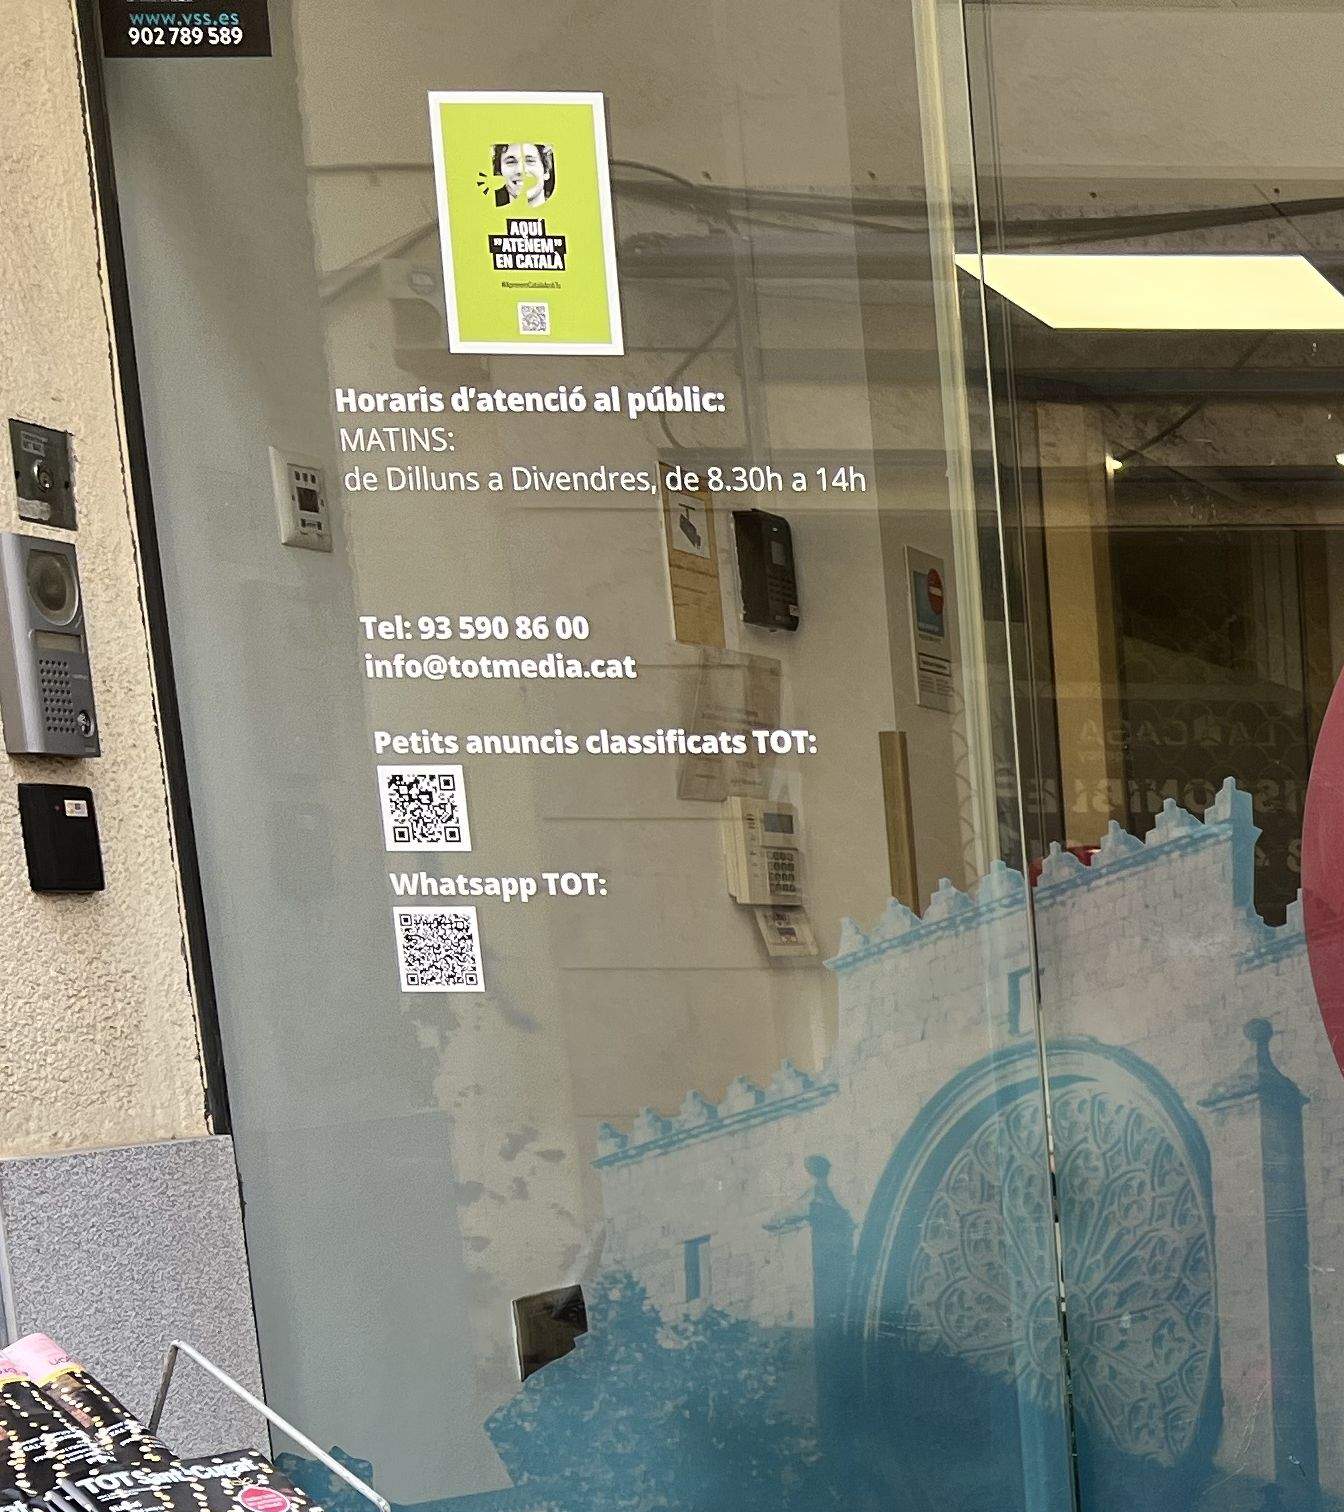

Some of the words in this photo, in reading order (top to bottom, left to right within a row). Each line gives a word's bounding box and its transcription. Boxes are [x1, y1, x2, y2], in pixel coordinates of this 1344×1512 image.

[129, 13, 240, 26] www.vss.es
[128, 27, 165, 45] 902
[169, 27, 203, 45] 789
[208, 27, 243, 45] 589
[495, 253, 513, 269] EN
[515, 251, 563, 270] CATALÀ
[335, 385, 445, 413] Horaris
[450, 385, 587, 412] d'atenció
[593, 385, 621, 412] al
[627, 385, 726, 420] públic:
[340, 427, 455, 452] MATINS:
[344, 465, 378, 492] de
[386, 465, 480, 492] Dilluns
[487, 471, 504, 492] a
[511, 465, 657, 495] Divendres,
[665, 465, 700, 492] de
[707, 465, 783, 492] 8.30h
[791, 472, 807, 492] a
[816, 465, 867, 492] 14h
[359, 614, 413, 640] Tel:
[417, 615, 453, 640] 93
[459, 615, 509, 640] 590
[515, 615, 550, 640] 86
[555, 615, 590, 640] 00
[364, 652, 637, 680] info@totmedia.cat
[374, 728, 460, 755] Petits
[466, 728, 580, 755] anuncis
[585, 728, 747, 754] classificats
[751, 729, 818, 754] TOT:
[388, 871, 537, 903] Whatsapp
[541, 872, 608, 896] TOT:
[75, 1470, 135, 1494] TOT
